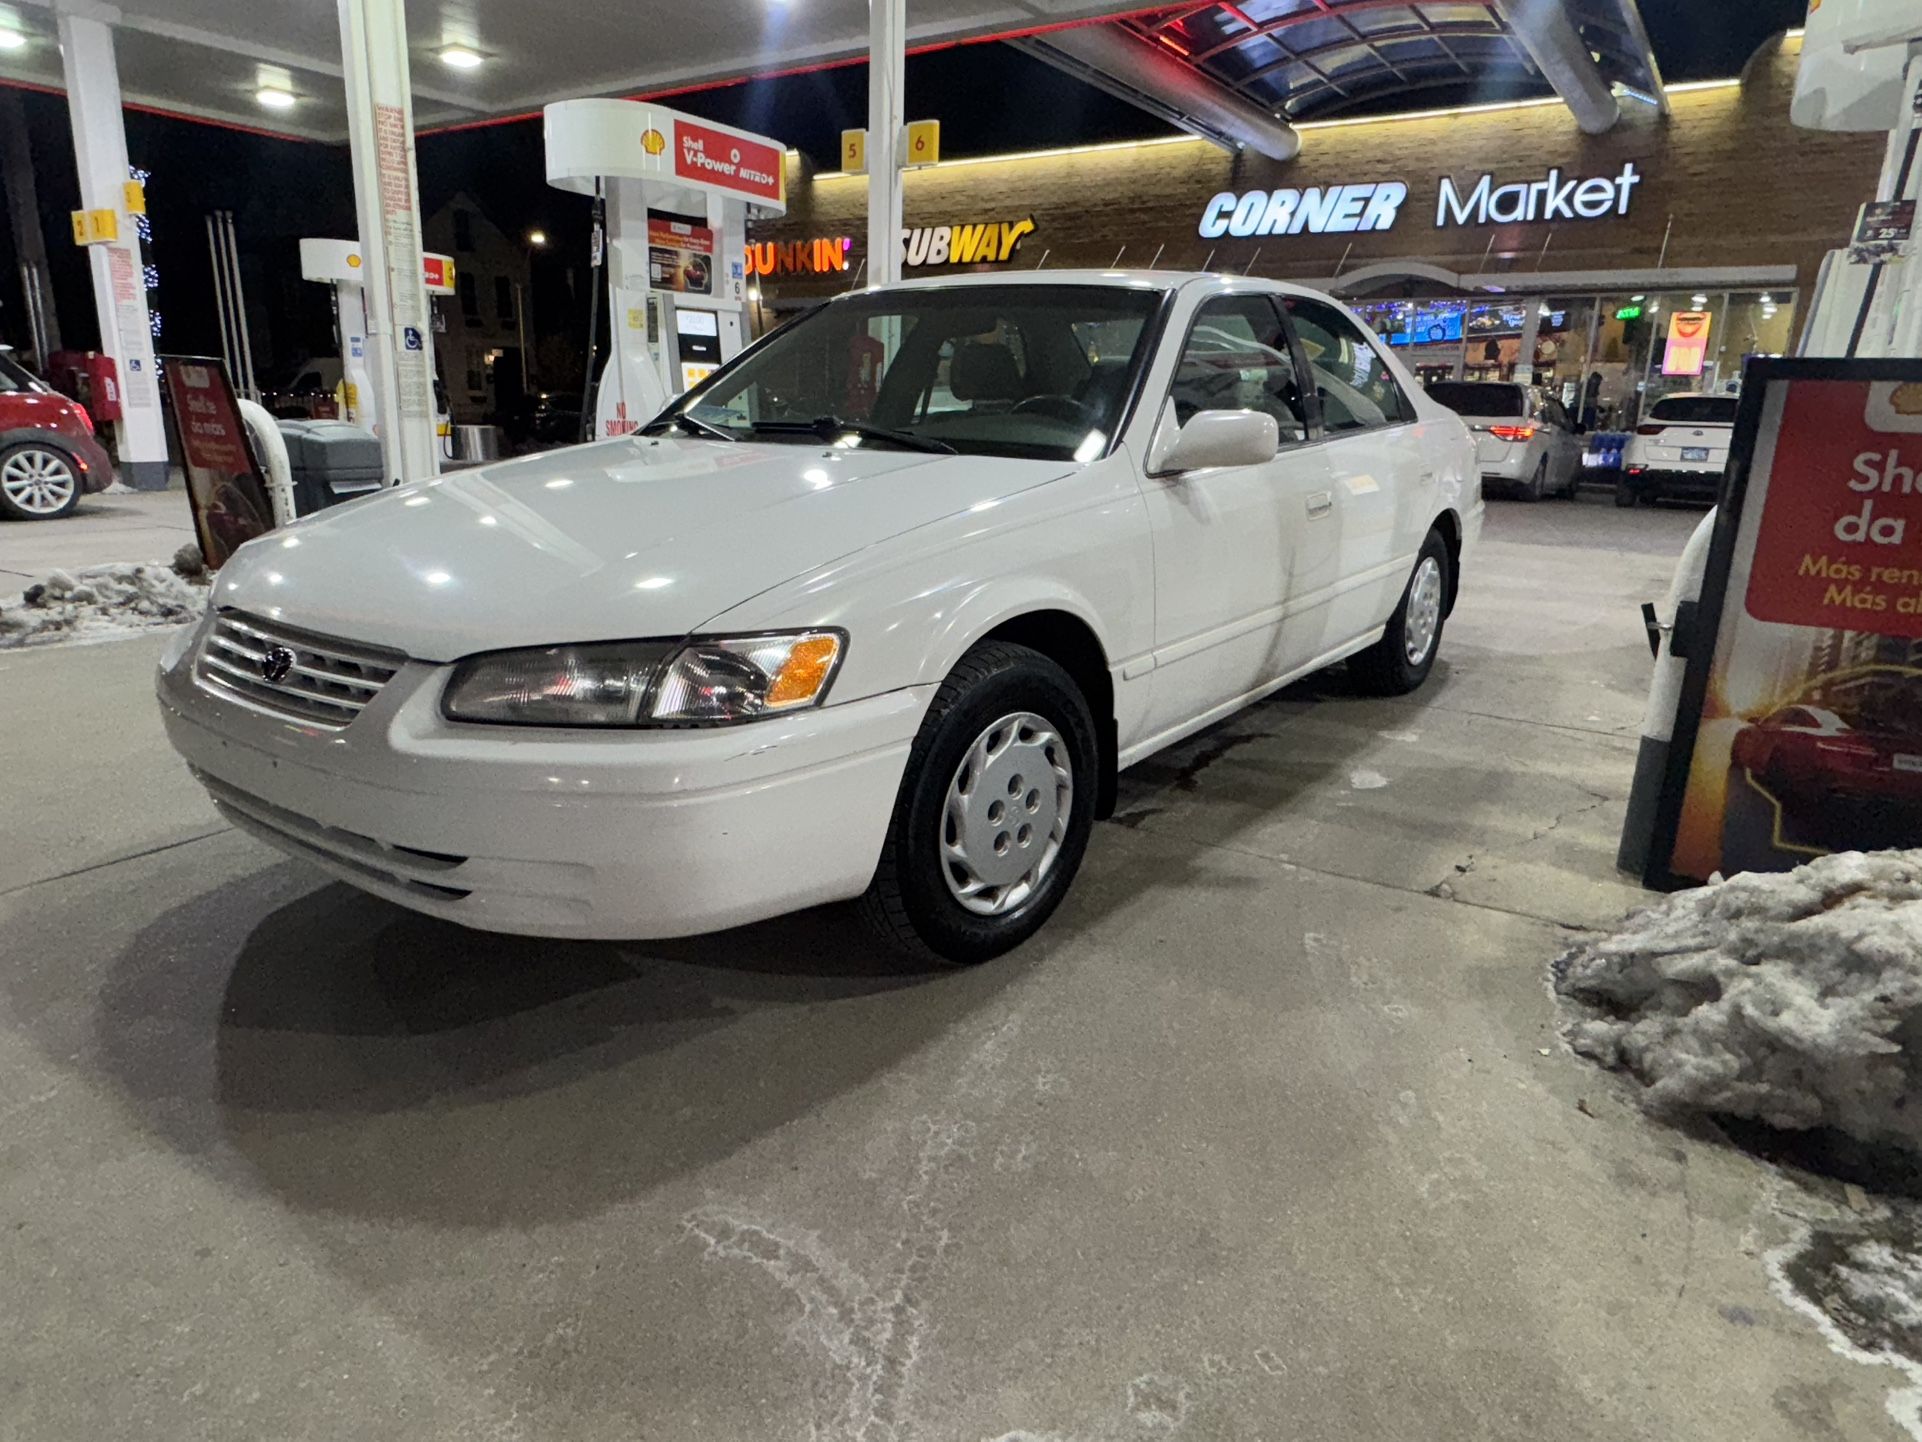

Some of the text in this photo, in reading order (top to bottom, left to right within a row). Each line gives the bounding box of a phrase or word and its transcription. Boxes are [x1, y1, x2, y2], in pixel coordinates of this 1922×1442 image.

[683, 136, 704, 151] Shell
[848, 143, 857, 159] 5
[915, 135, 925, 152] 6
[683, 148, 775, 186] V-Power NITRO+
[1199, 163, 1640, 238] CORNER Market
[734, 281, 741, 295] 6
[1616, 306, 1640, 319] ATM
[616, 402, 627, 420] NO
[606, 419, 639, 437] SMOKING
[1833, 499, 1906, 545] da
[1798, 553, 1922, 585] Más ren
[1823, 583, 1887, 611] Más
